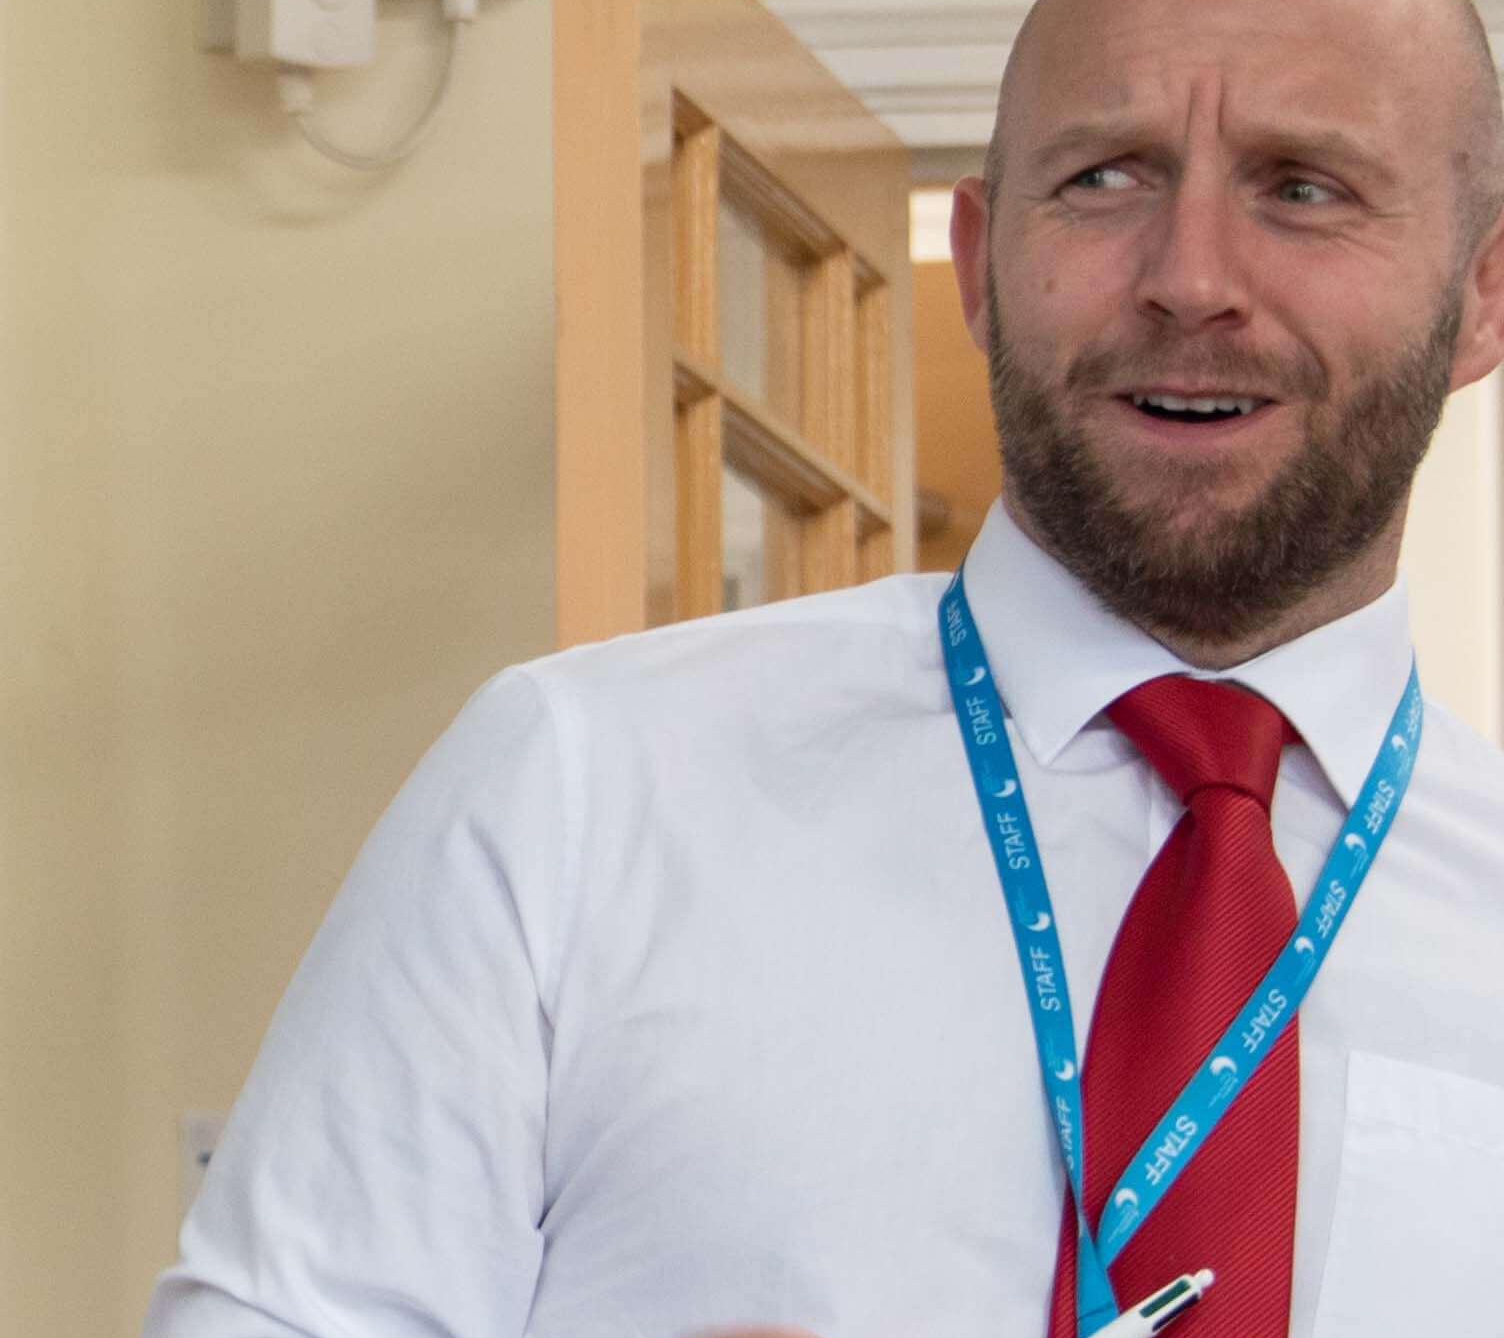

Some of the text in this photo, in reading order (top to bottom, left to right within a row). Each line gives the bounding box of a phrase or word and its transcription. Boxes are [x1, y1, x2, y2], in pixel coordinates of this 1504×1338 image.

[965, 695, 998, 746] STAFF
[1363, 779, 1396, 835] STAFF
[996, 812, 1031, 871] STAFF
[1314, 878, 1347, 938] STAFF
[1029, 946, 1061, 1012] STAFF
[1241, 988, 1287, 1054] STAFF
[1144, 1114, 1199, 1186] STAFF
